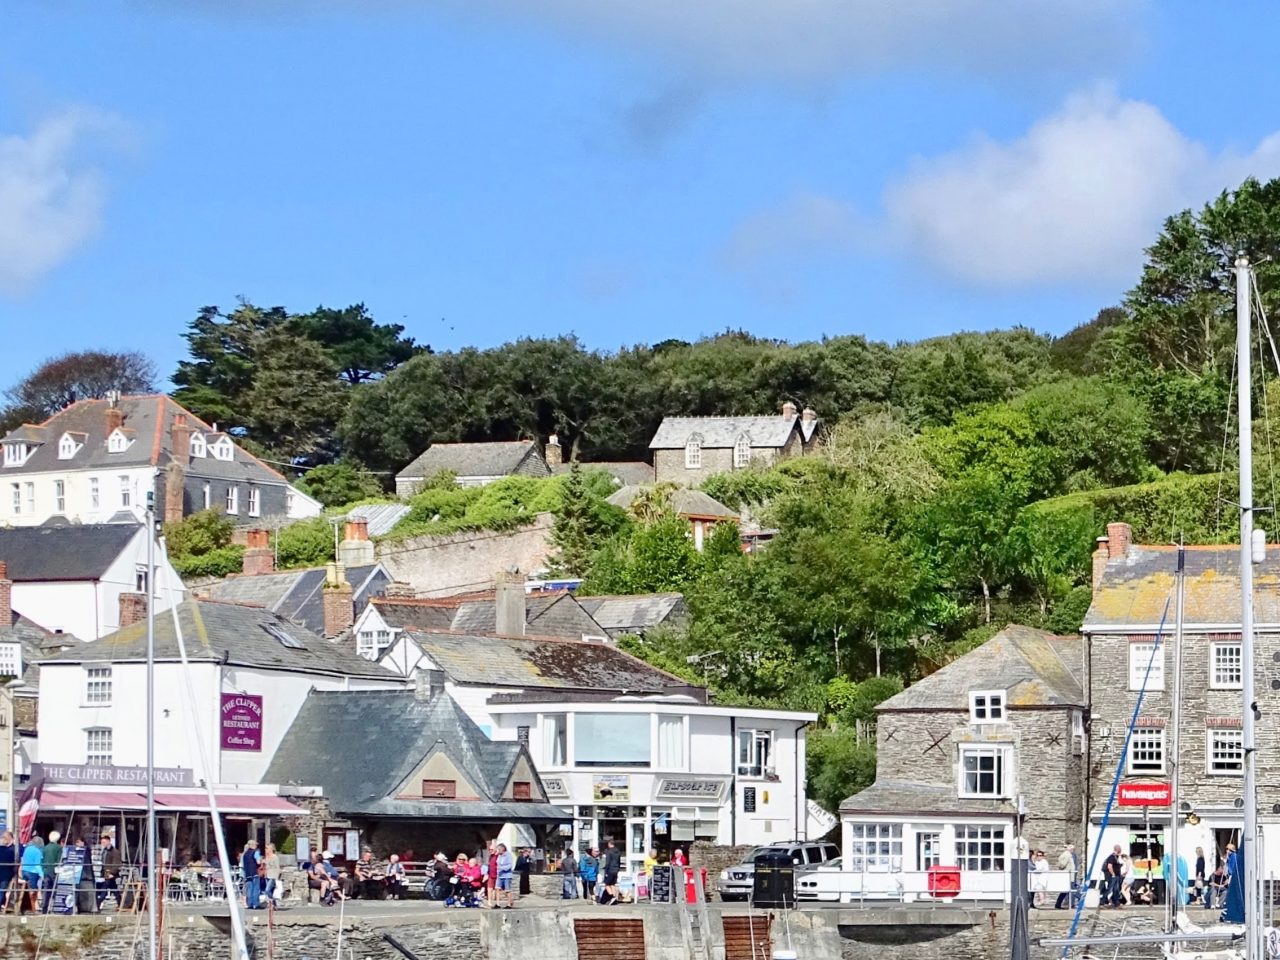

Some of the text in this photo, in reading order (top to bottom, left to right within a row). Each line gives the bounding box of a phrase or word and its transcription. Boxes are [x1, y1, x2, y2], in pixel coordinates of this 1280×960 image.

[222, 697, 261, 717] THE CLIPPER
[223, 720, 259, 729] RESTAURANT
[42, 766, 64, 779] THE
[67, 767, 113, 780] CLIPPER
